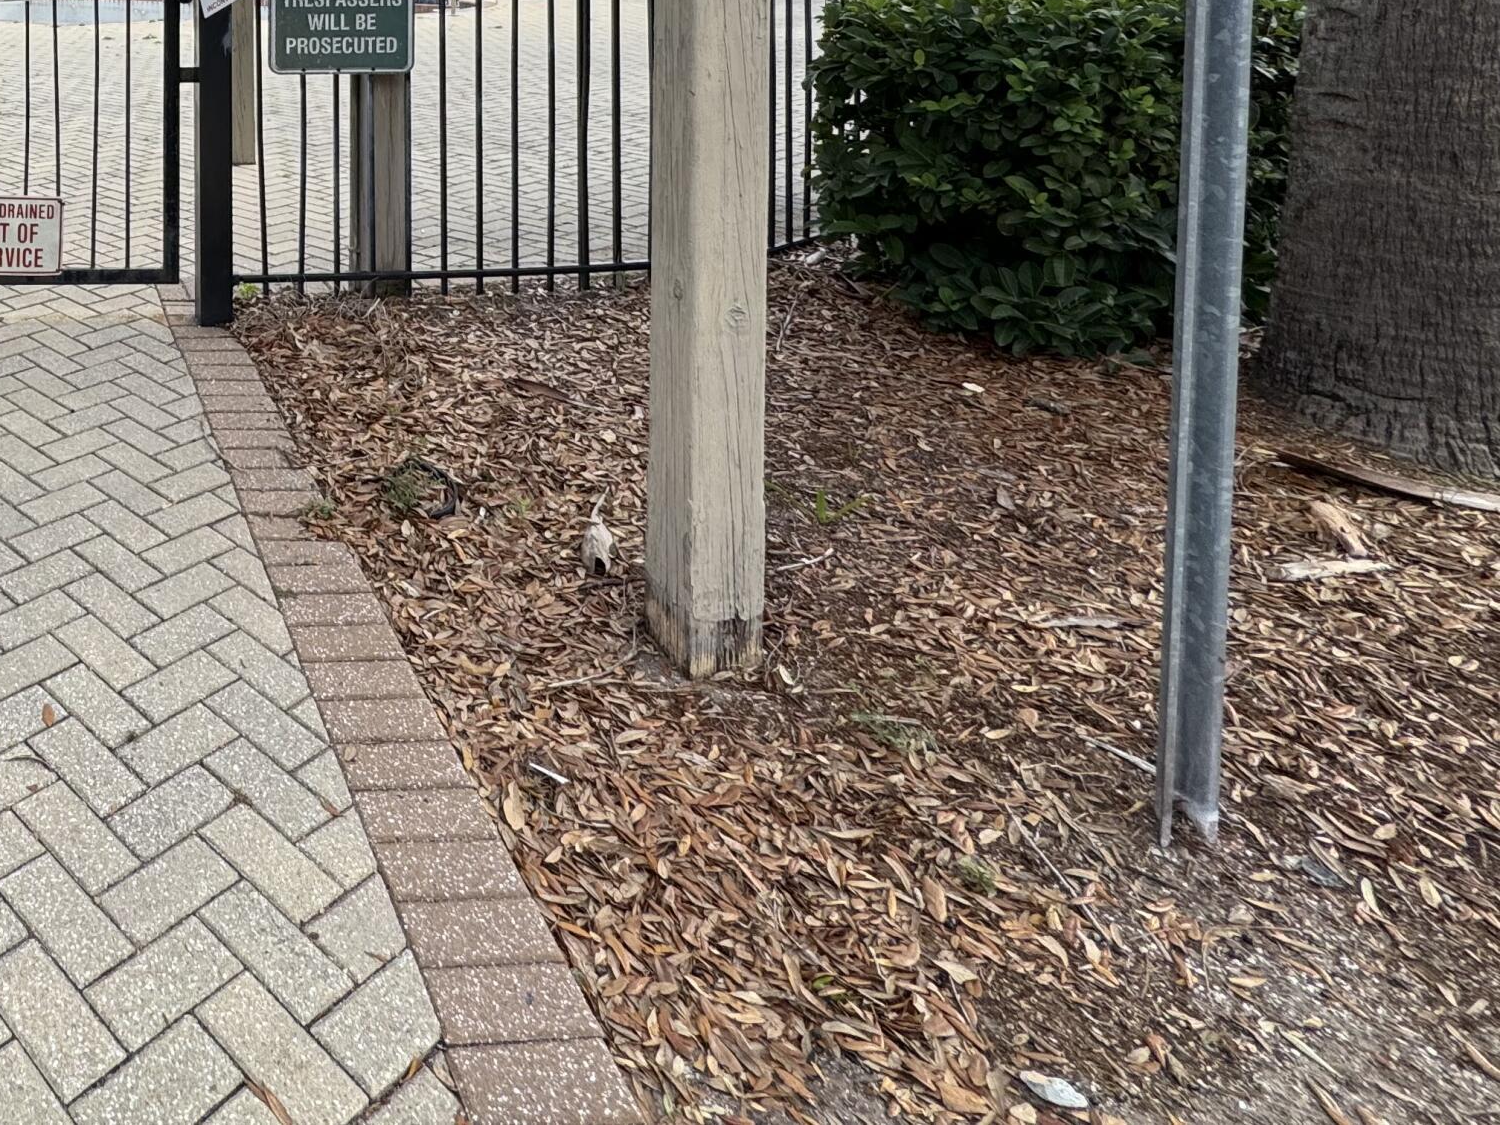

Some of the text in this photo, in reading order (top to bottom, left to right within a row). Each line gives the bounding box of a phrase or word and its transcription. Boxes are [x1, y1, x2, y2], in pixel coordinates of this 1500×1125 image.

[308, 14, 376, 31] WILL BE
[286, 37, 397, 54] PROSECUTED
[0, 203, 54, 219] DRAINED
[18, 224, 39, 243] OF
